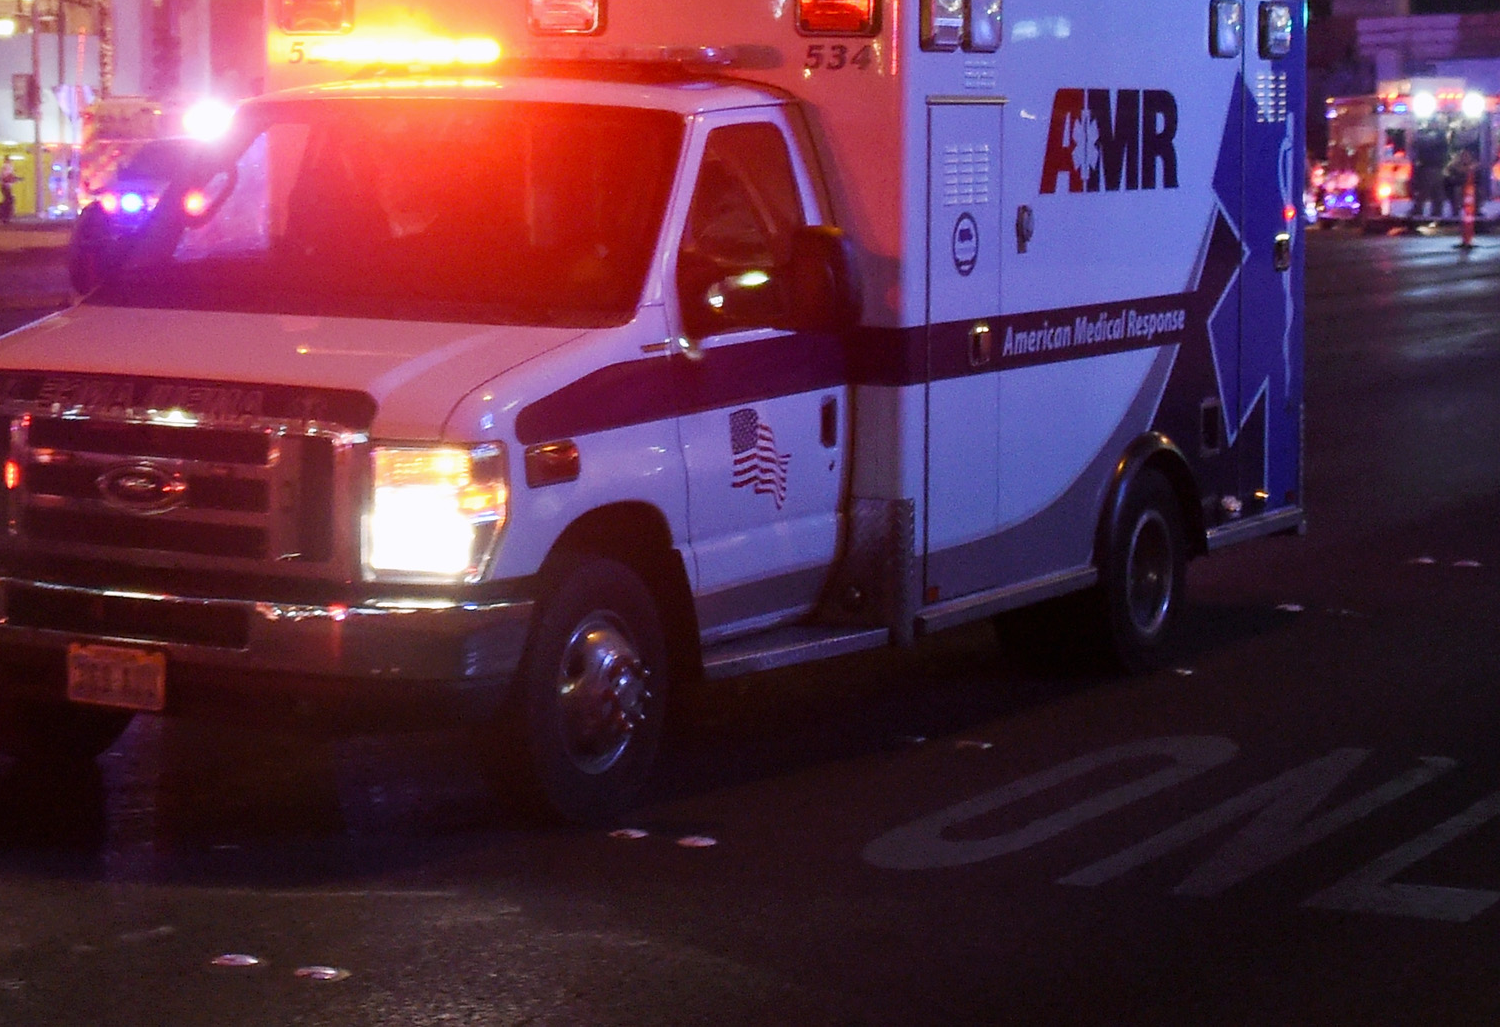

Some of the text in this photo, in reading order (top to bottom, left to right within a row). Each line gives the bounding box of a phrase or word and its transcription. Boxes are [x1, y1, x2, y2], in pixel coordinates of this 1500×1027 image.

[804, 44, 871, 70] 534
[1040, 88, 1179, 194] AMR
[1002, 309, 1186, 356] American Medical Response
